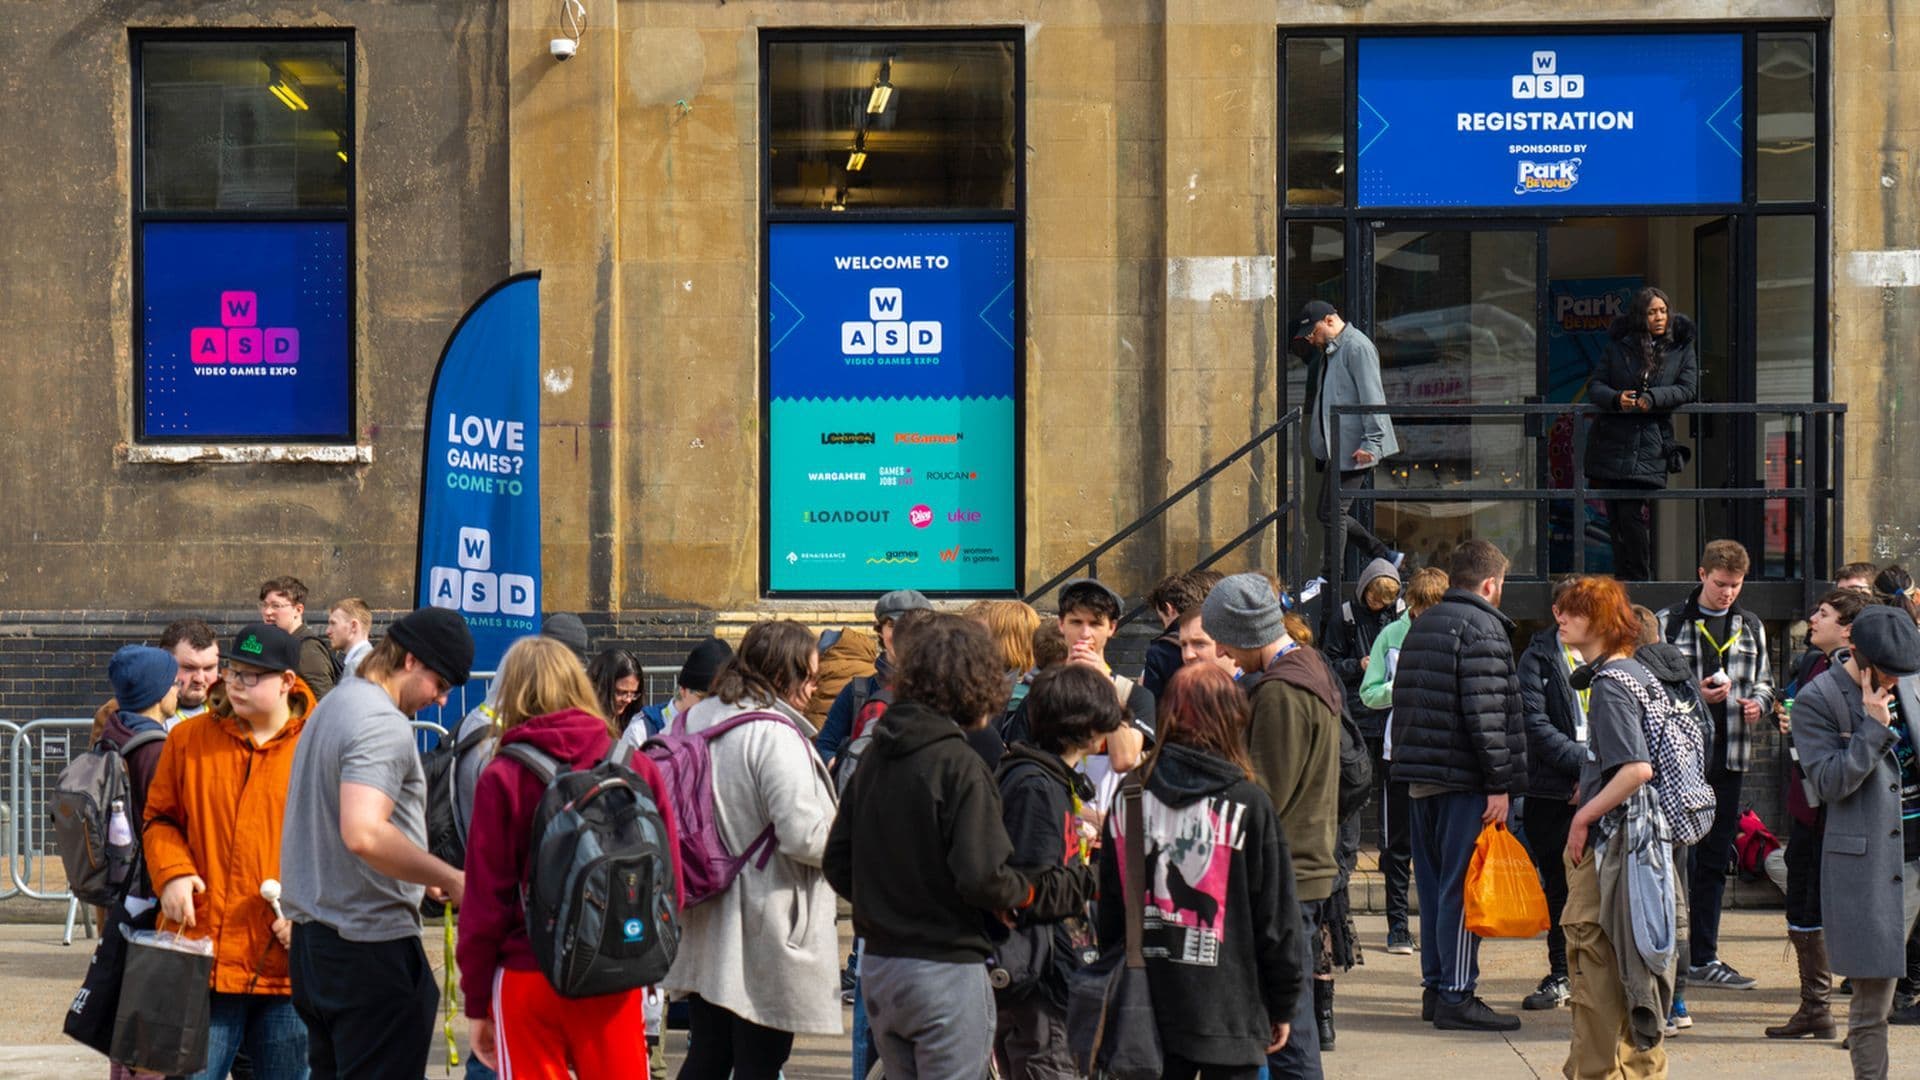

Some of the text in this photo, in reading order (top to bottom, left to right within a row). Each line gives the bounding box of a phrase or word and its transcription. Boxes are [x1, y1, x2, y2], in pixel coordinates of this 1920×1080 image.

[1536, 57, 1552, 69] W
[1456, 112, 1634, 131] REGISTRATION
[1509, 144, 1588, 153] SPONSORED BY
[1519, 162, 1576, 183] Park
[834, 255, 949, 270] WELCOME TO
[228, 301, 250, 317] W
[875, 296, 897, 312] W
[1556, 294, 1623, 322] Park
[844, 357, 940, 366] VIDEO GAMES EXPO
[194, 367, 297, 376] VIDEO GAMES EXPO
[448, 413, 525, 452] LOVE
[447, 448, 524, 475] GAMES?
[808, 472, 866, 481] WARGAMER
[879, 466, 904, 476] GAMES
[926, 471, 970, 480] ROUCAN
[446, 472, 523, 496] COME TO
[879, 476, 896, 486] JOBS
[947, 507, 982, 523] ukie
[464, 537, 485, 560] W
[885, 550, 918, 561] games
[506, 619, 534, 631] EXPO
